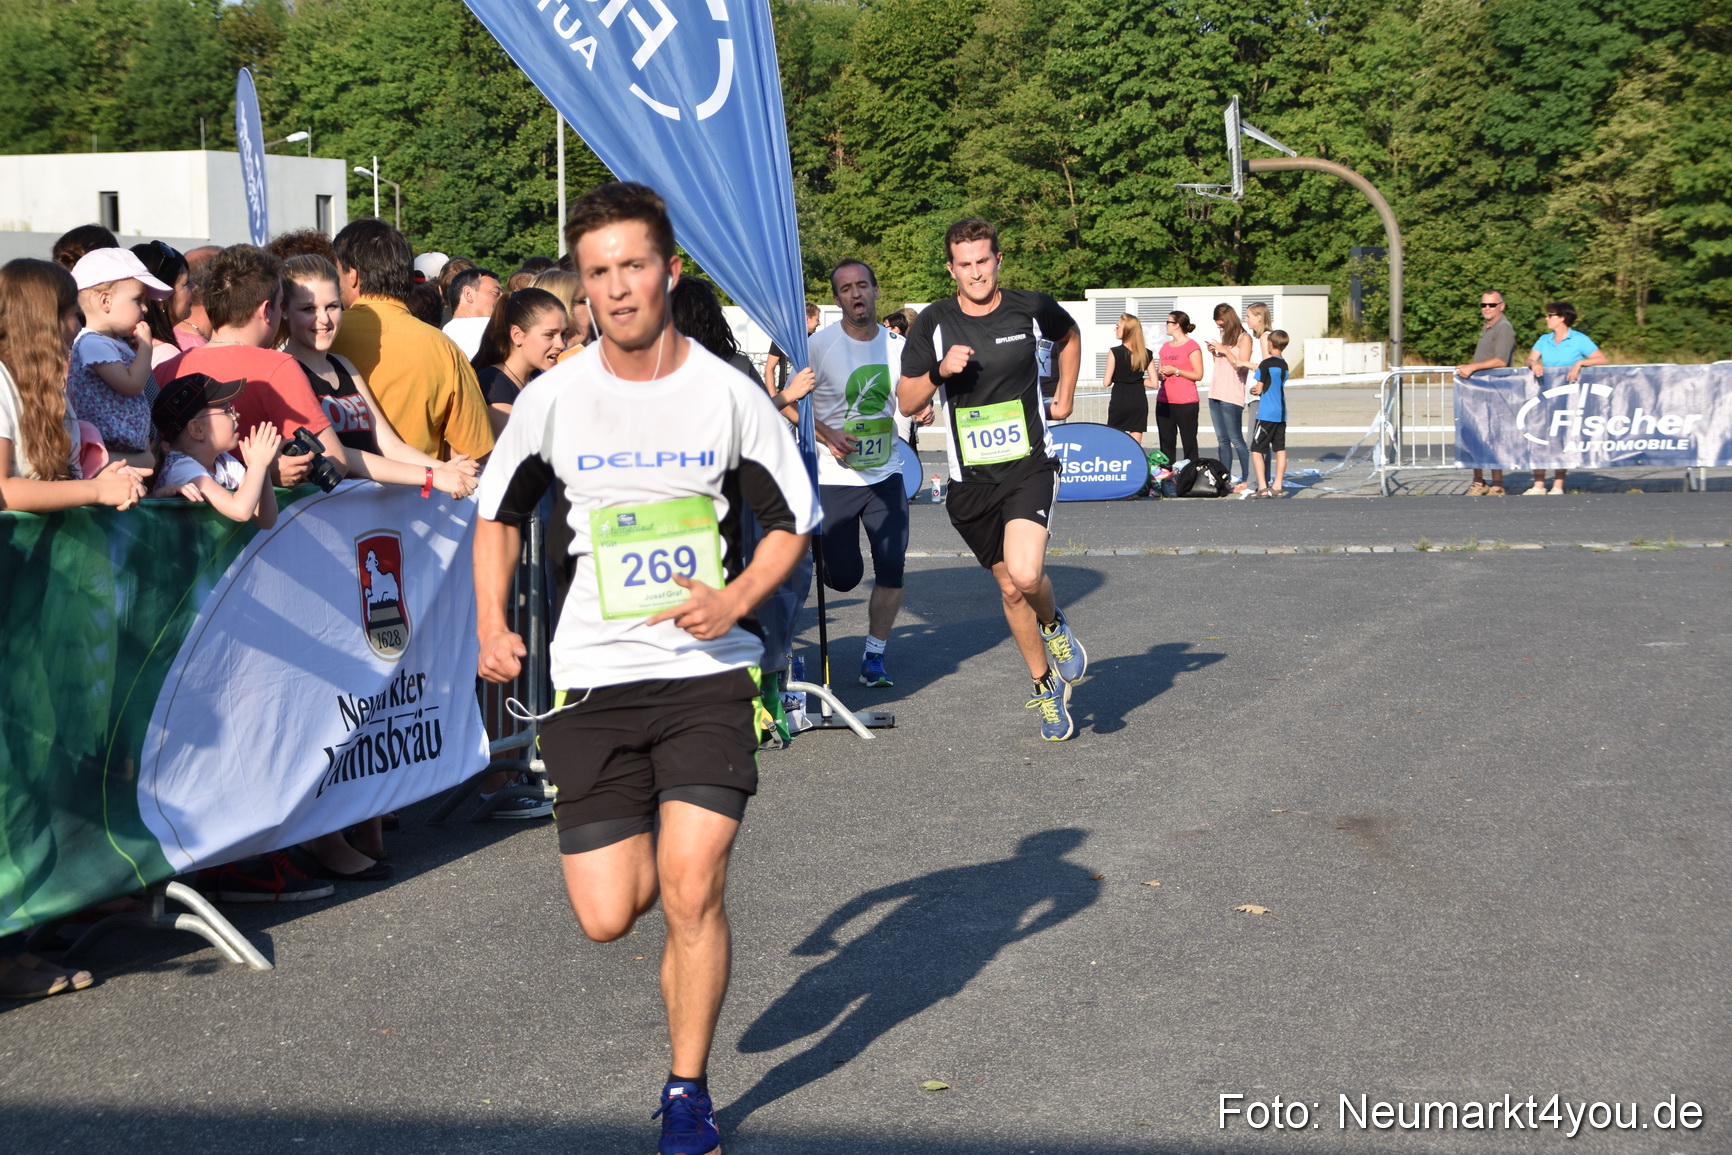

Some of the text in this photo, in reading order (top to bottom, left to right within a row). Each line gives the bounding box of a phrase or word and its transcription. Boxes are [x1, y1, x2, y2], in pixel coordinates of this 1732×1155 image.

[321, 394, 370, 432] OBE
[1550, 408, 1702, 437] Fischer
[967, 424, 1021, 449] 1095
[1562, 439, 1690, 453] AUTOMOBILE
[855, 438, 882, 456] 121
[577, 450, 715, 471] DELPHI
[1060, 456, 1132, 474] ischer
[1061, 474, 1127, 483] AUTOMOBILE
[621, 545, 697, 588] 269
[645, 590, 683, 600] Josef Graf
[377, 629, 401, 649] 1628
